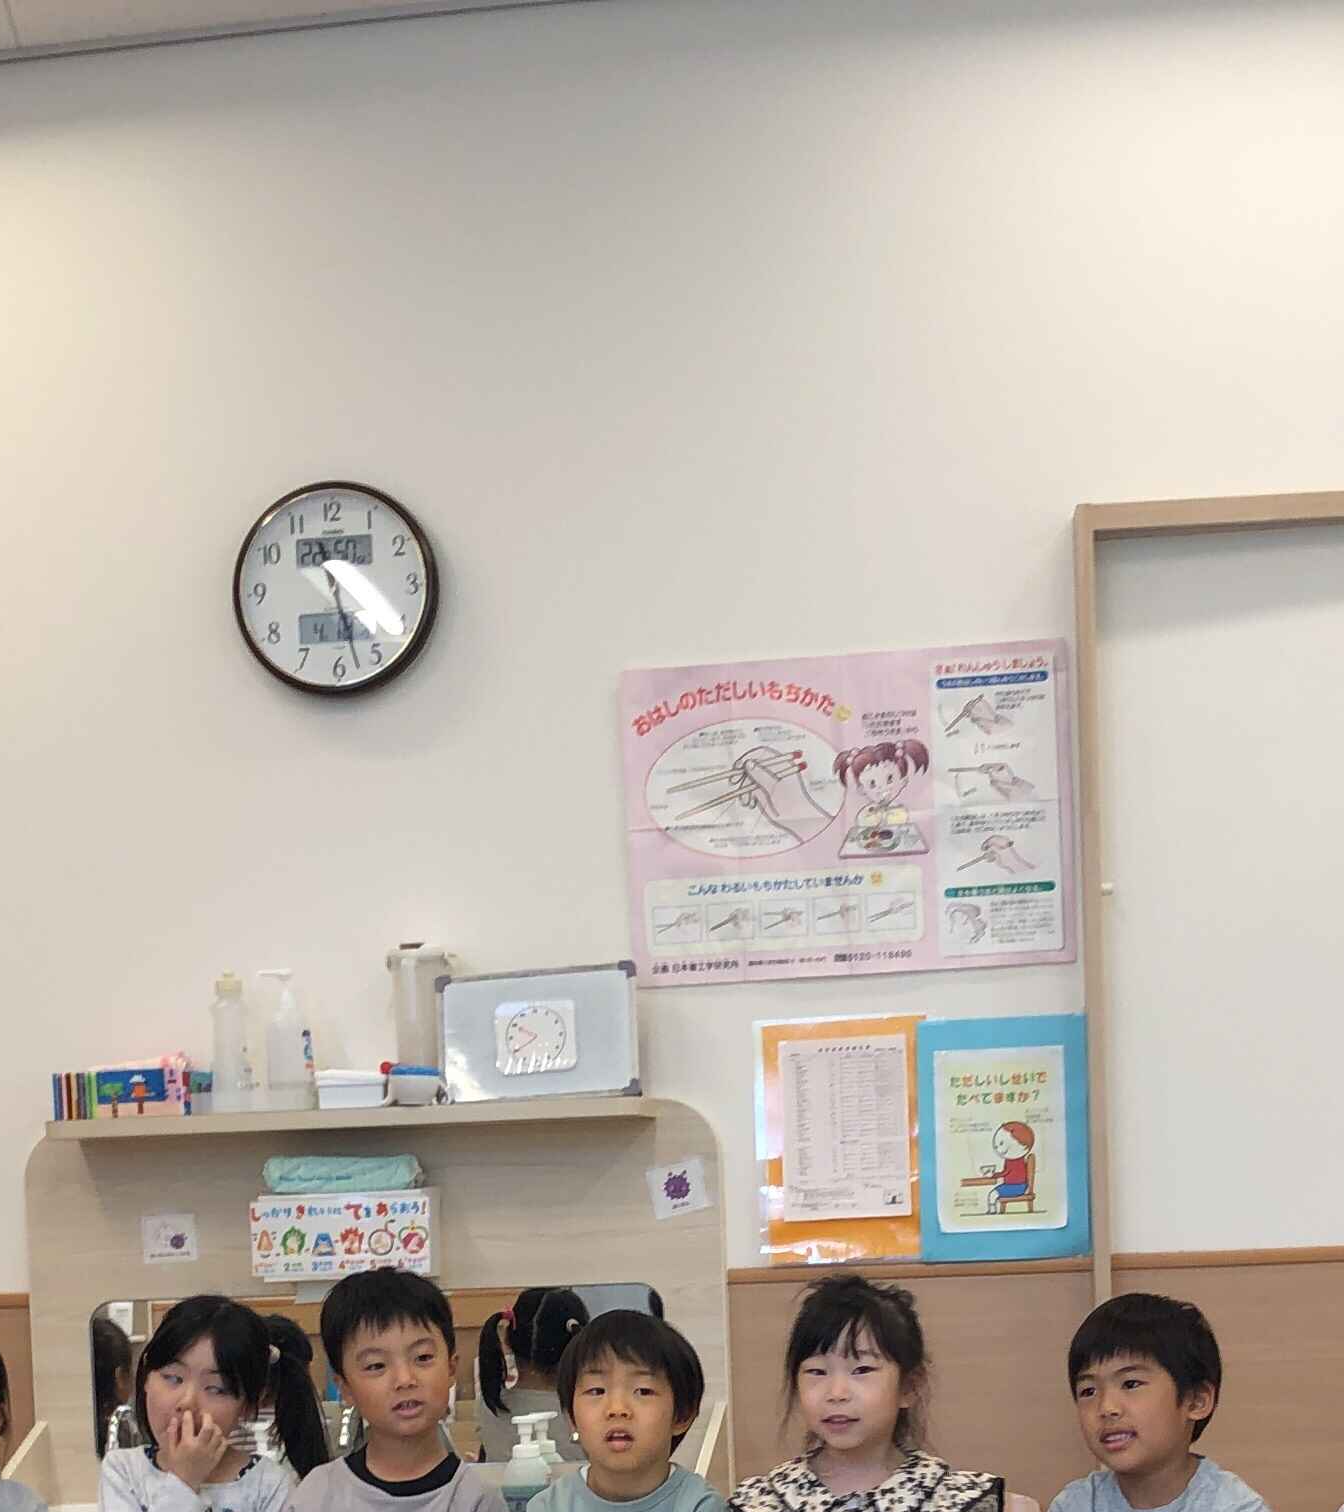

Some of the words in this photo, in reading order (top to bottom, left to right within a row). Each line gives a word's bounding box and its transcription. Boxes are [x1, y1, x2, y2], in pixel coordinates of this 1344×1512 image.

[323, 500, 341, 522] 12
[289, 514, 304, 536] 11
[262, 542, 281, 565] 10
[392, 535, 406, 557] 2
[253, 583, 267, 605] 9
[406, 572, 419, 595] 3
[267, 622, 281, 644] 8
[296, 648, 310, 672] 7
[370, 643, 383, 665] 5
[332, 656, 346, 679] 6
[632, 680, 836, 737] おはしのただしいもちかた
[949, 1071, 1047, 1088] ただしいしせいで
